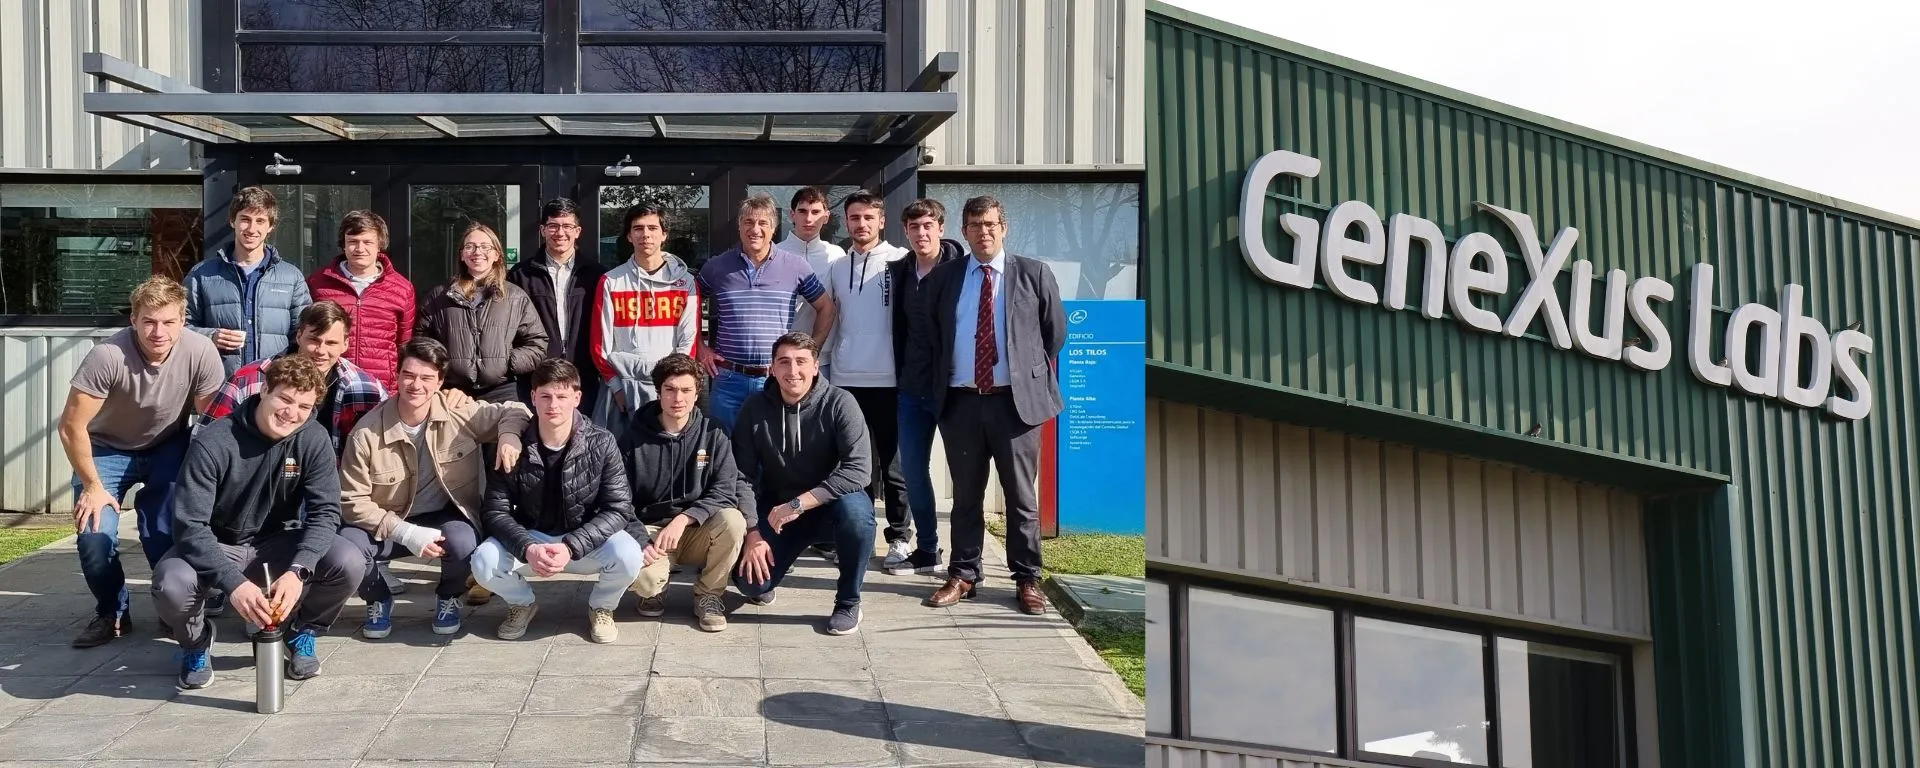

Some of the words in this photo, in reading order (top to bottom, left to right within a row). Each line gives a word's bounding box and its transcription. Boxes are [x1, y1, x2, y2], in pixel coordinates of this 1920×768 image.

[614, 296, 685, 321] 49ERS
[1239, 149, 1674, 371] GeneXus
[1688, 262, 1873, 420] Labs
